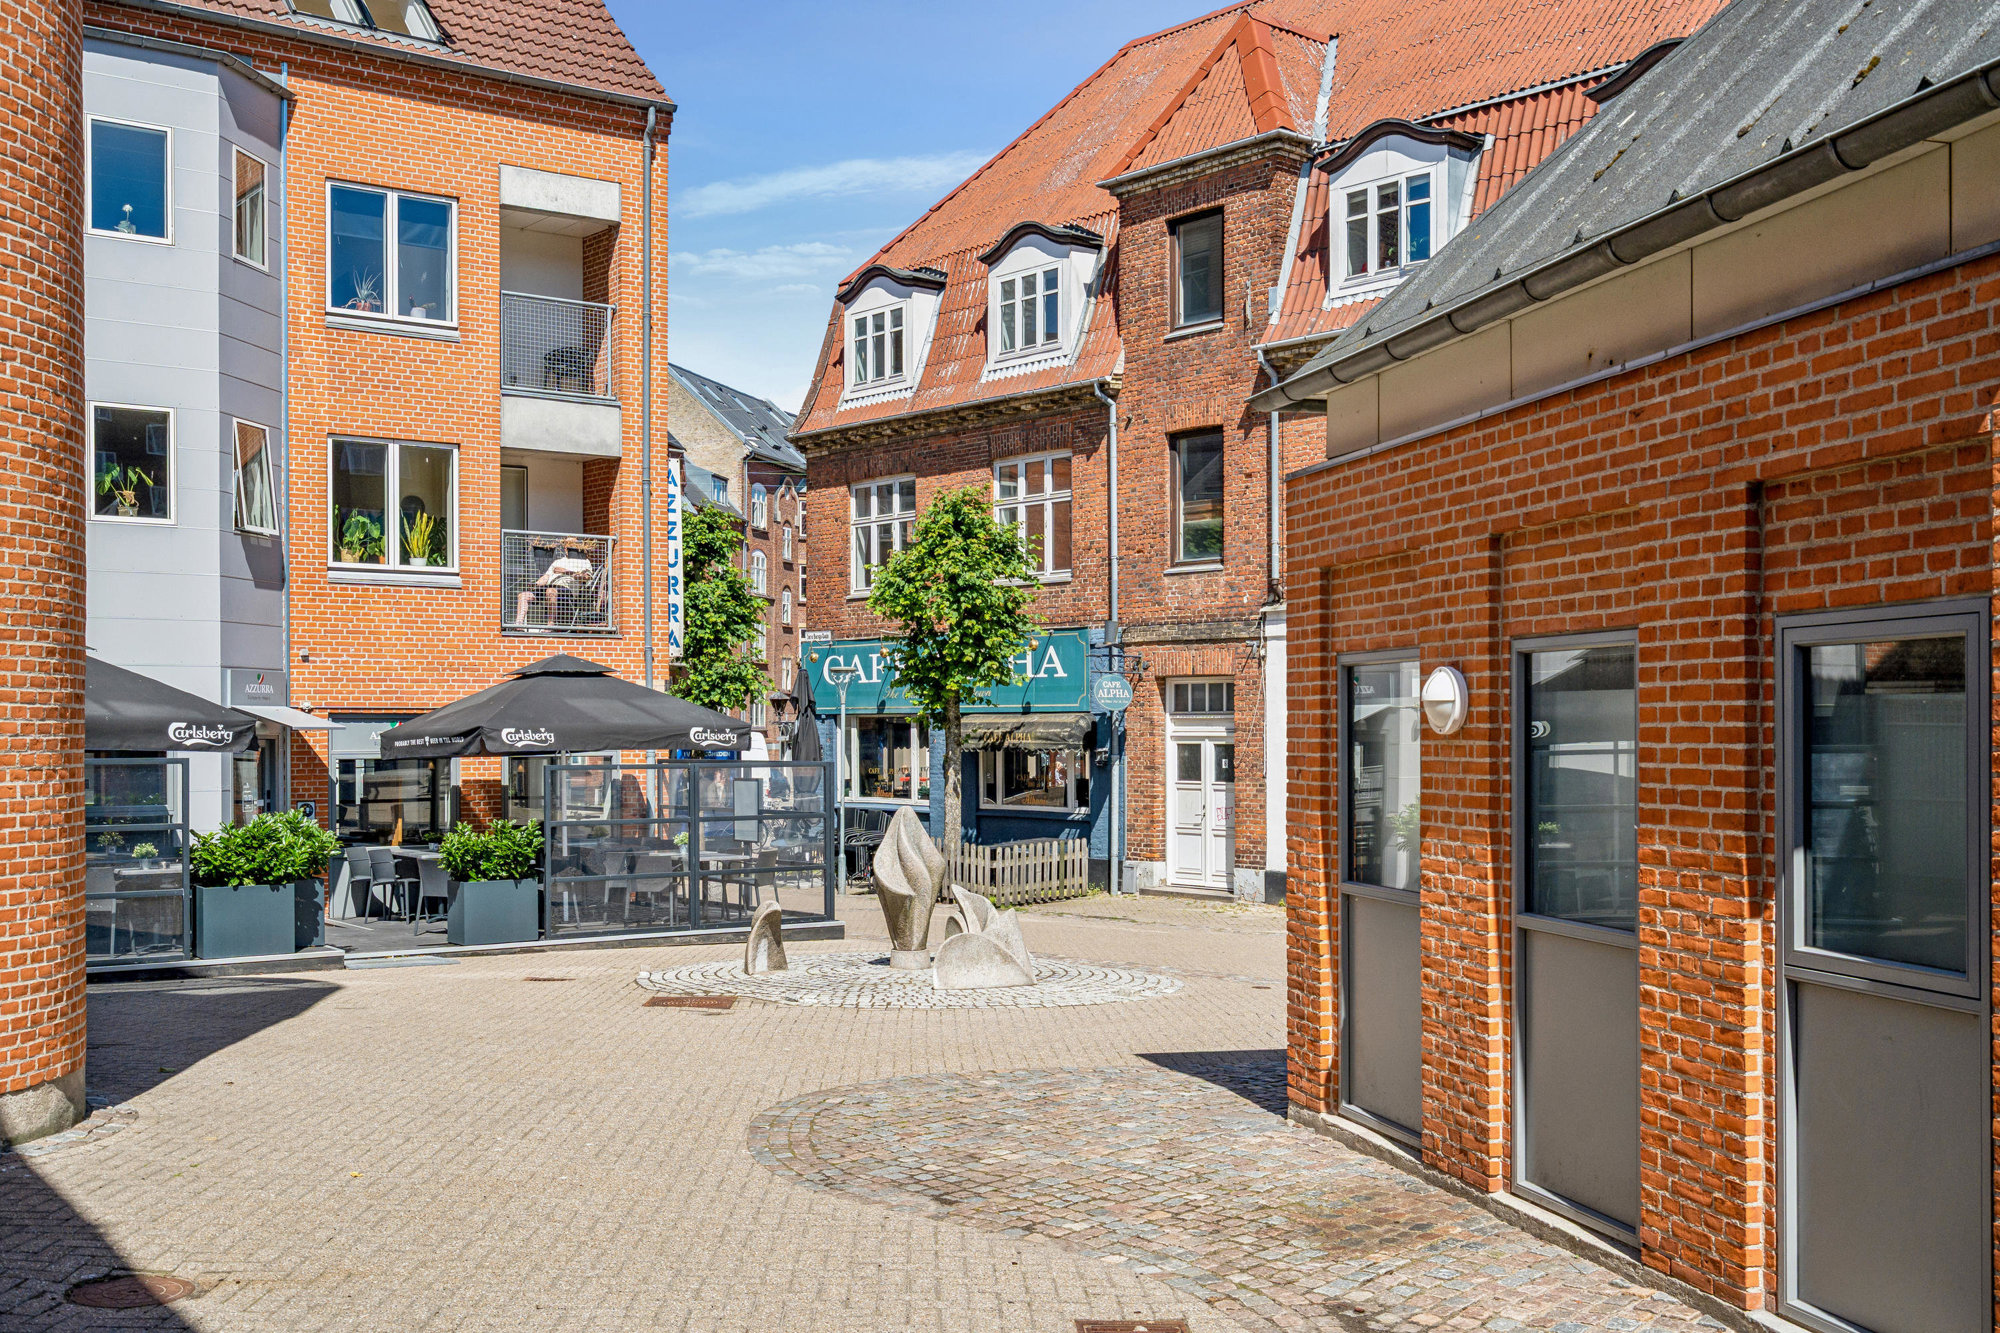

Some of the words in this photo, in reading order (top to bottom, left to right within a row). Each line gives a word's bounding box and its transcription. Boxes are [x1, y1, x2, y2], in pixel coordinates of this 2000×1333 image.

[245, 684, 275, 694] AZZURRA
[1102, 680, 1122, 689] CAFE
[1098, 689, 1131, 698] ALPHA
[168, 722, 235, 747] Carlsberg
[501, 728, 555, 748] Carlsberg
[690, 727, 738, 747] Carlsberg
[1005, 731, 1032, 742] ALPHA
